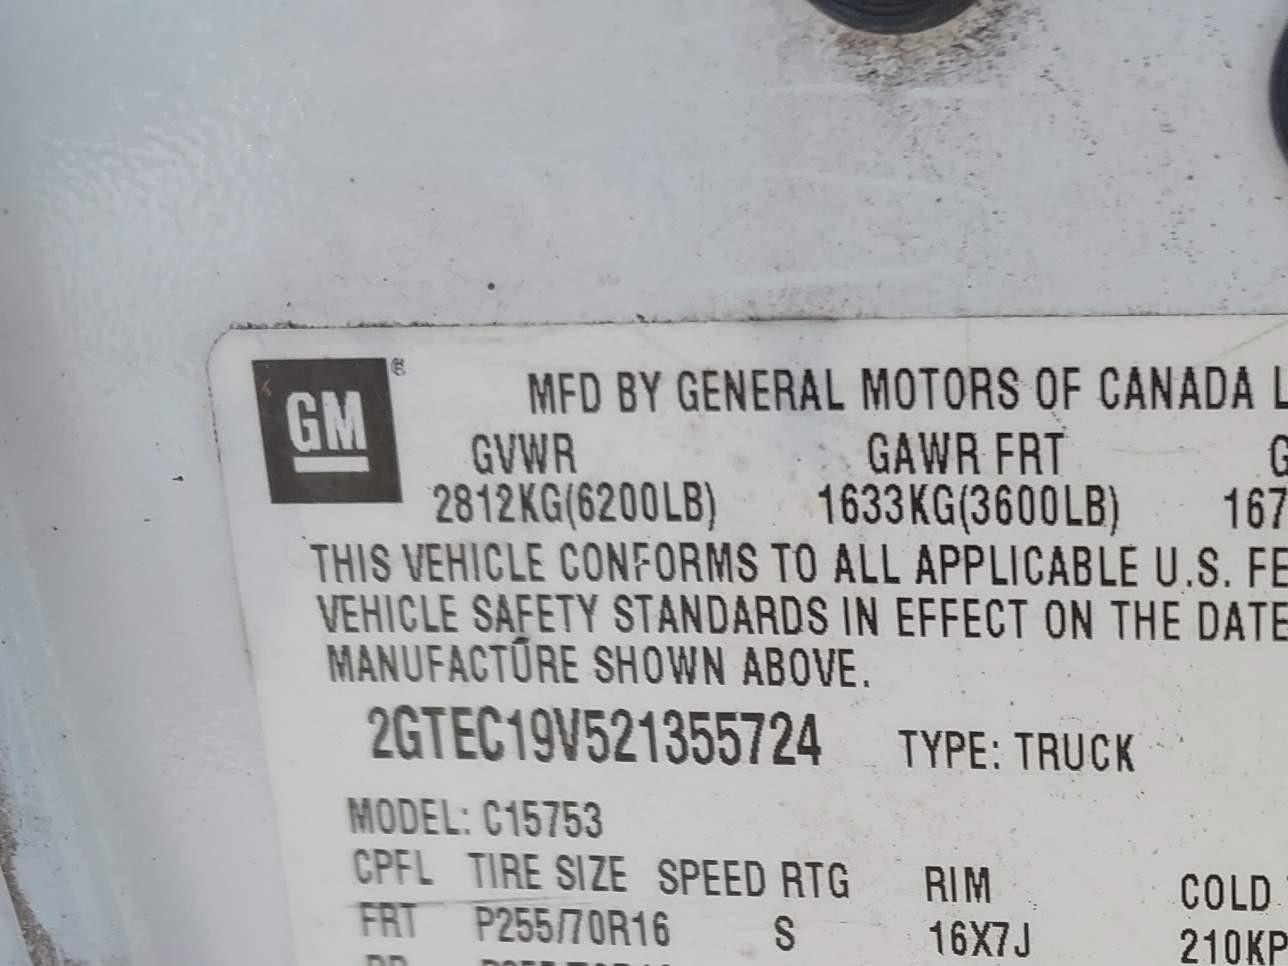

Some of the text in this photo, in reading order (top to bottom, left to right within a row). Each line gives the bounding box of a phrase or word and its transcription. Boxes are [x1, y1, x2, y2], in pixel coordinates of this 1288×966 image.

[528, 372, 601, 414] MFD
[617, 371, 661, 413] BY
[677, 368, 845, 412] GENERAL
[861, 367, 1019, 410] MOTORS
[1036, 367, 1081, 410] OF
[1099, 366, 1254, 410] CANADA
[285, 390, 367, 452] GM
[472, 433, 577, 475] GVWR
[868, 432, 1065, 475] GAWR FRT
[433, 481, 716, 531] 2812KG(6200LB)
[818, 483, 1119, 536] 1633KG(3600LB)
[310, 544, 391, 583] THIS
[402, 542, 545, 582] VEHICLE
[560, 542, 758, 583] CONFORMS
[774, 543, 817, 583] TO
[834, 543, 901, 584] ALL
[915, 544, 1138, 587] APPLICABLE
[1156, 547, 1230, 587] U.S.
[316, 594, 458, 633] VEHICLE
[472, 594, 598, 633] SAFETY
[613, 594, 829, 635] STANDARDS
[843, 596, 878, 636] IN
[896, 597, 1028, 639] EFFECT
[1045, 600, 1093, 640] ON
[1110, 600, 1180, 641] THE
[1198, 601, 1288, 642] DATE
[327, 639, 869, 687] MANUFACTURE SHOWN ABOVE.
[368, 705, 822, 766] 2GTEC19V521355724
[898, 730, 1135, 772] TYPE: TRUCK
[347, 798, 603, 838] MODEL: C15753
[354, 849, 433, 885] CPFL
[467, 853, 627, 892] TIRE SIZE
[658, 859, 849, 898] SPEED RTG
[925, 866, 991, 903] RIM
[1181, 874, 1271, 911] COLD
[358, 902, 417, 937] FRT
[475, 906, 670, 946] P255/70R16
[774, 916, 795, 951] S
[929, 920, 1030, 958] 16X7J
